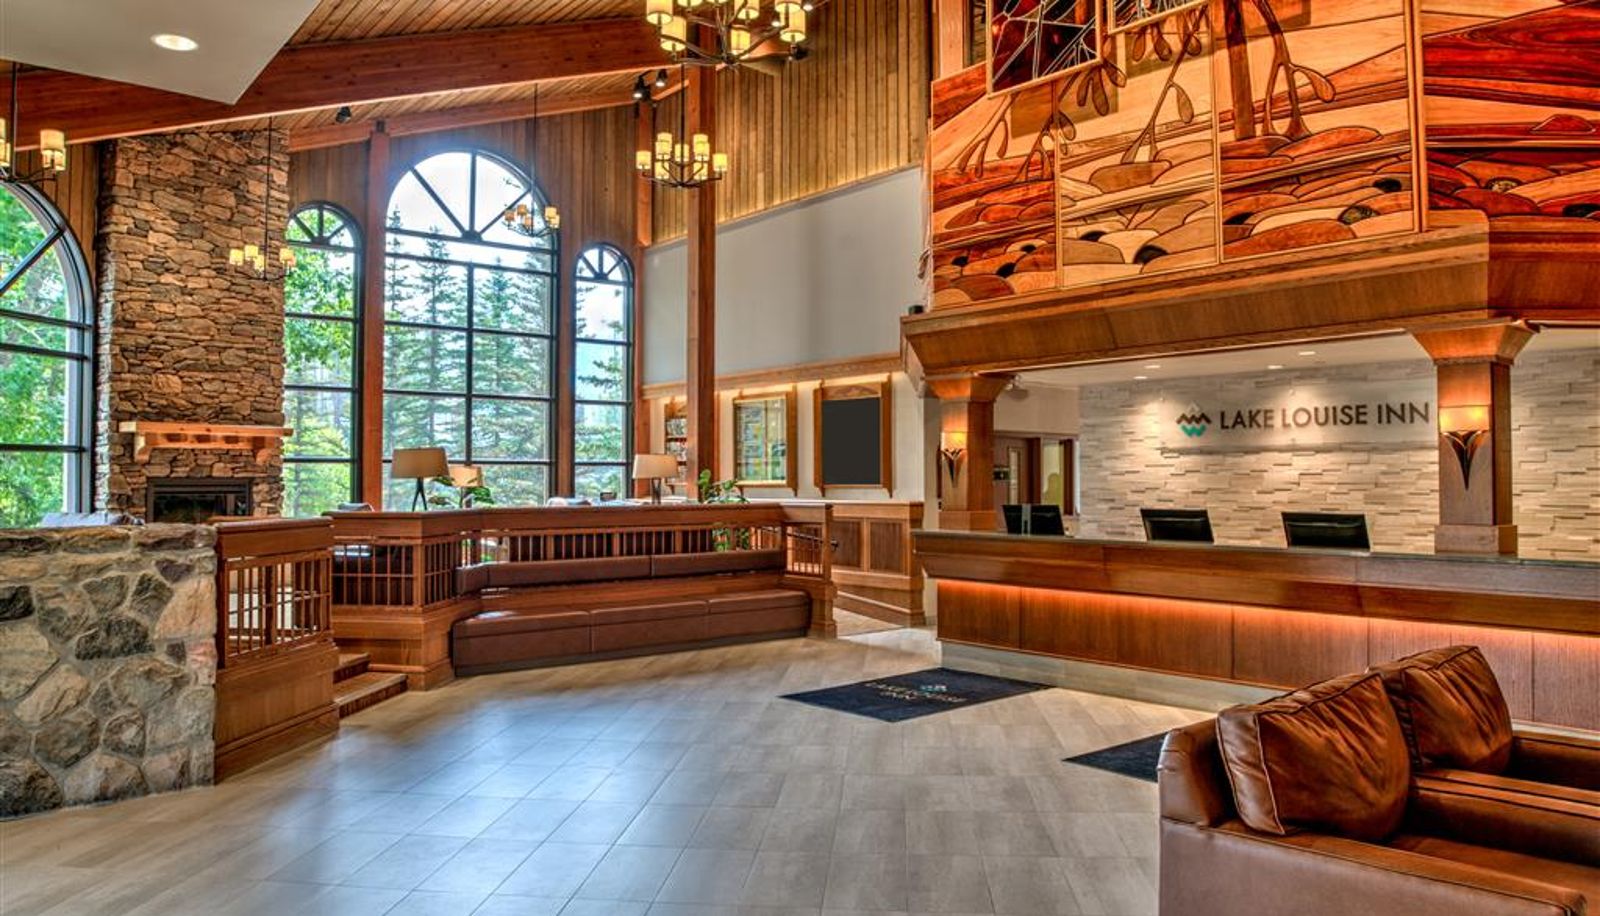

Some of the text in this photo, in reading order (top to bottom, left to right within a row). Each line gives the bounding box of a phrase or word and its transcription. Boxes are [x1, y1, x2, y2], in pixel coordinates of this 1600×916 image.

[1220, 402, 1430, 430] LAKE LOUISE INN
